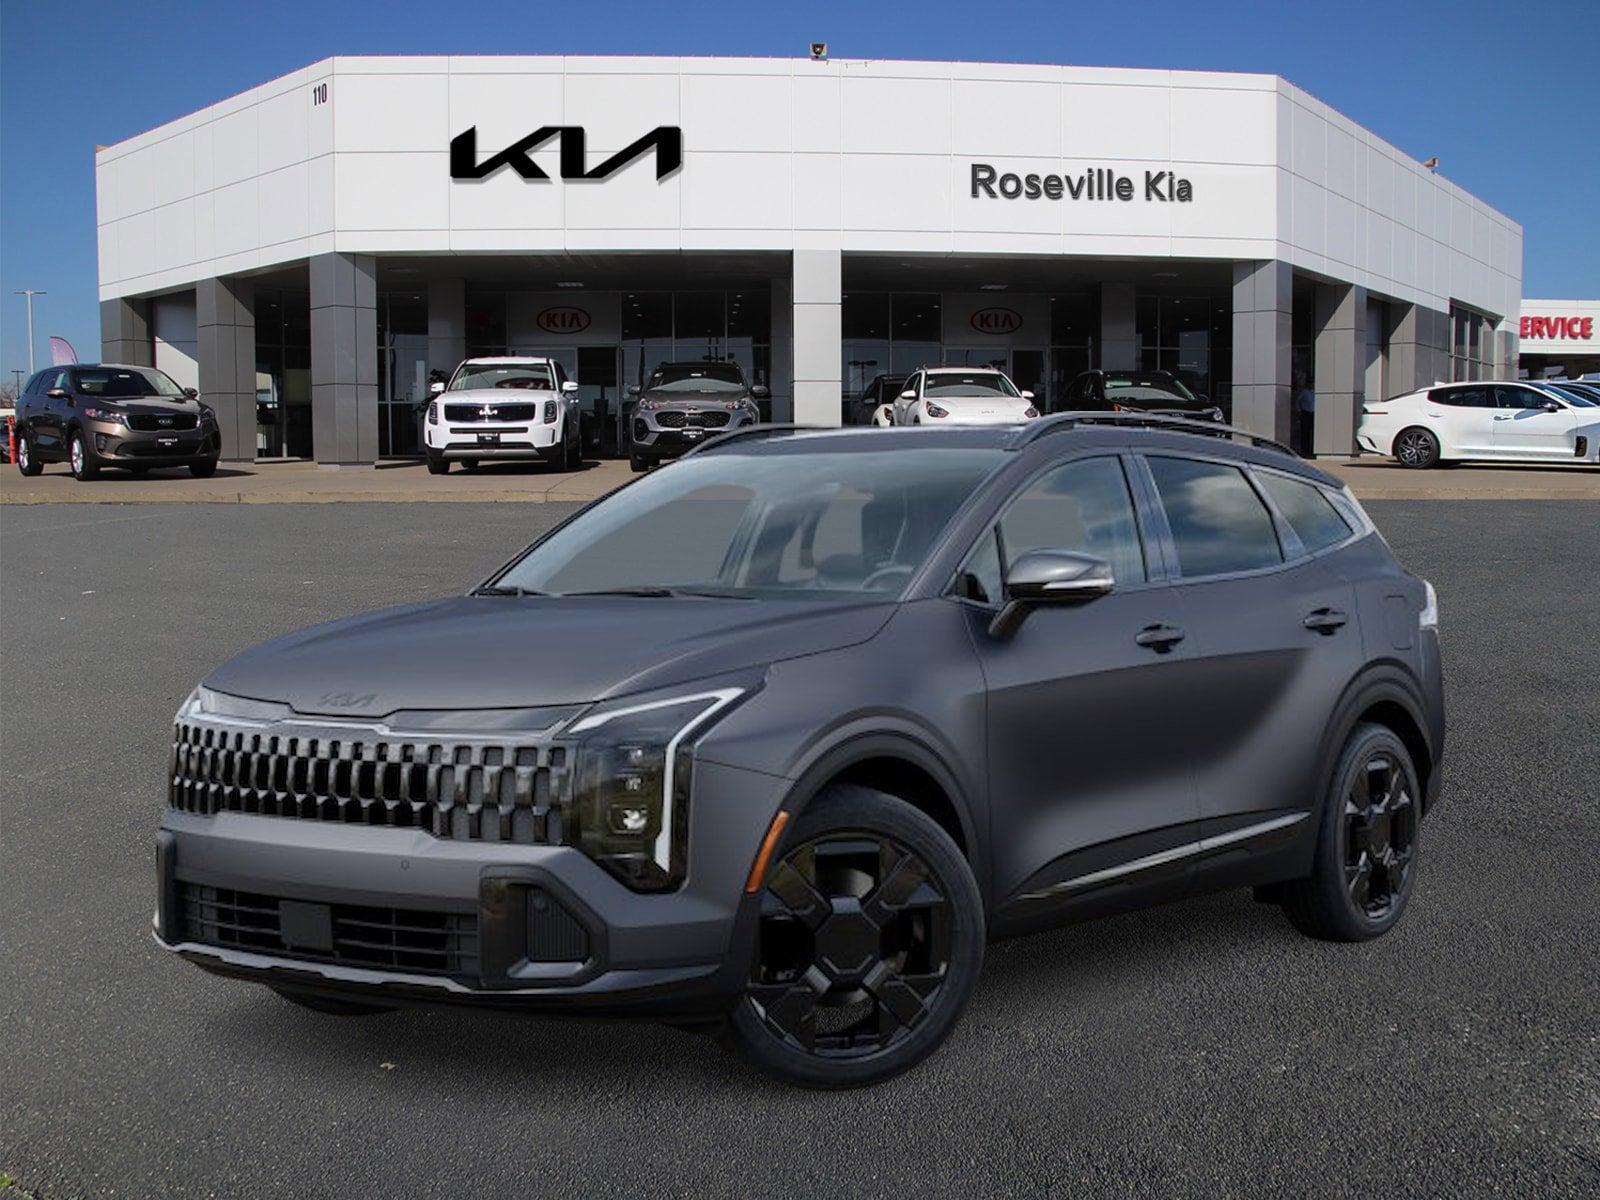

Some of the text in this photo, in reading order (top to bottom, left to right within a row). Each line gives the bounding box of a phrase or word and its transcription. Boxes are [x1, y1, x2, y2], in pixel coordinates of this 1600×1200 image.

[313, 83, 327, 106] 110
[971, 163, 1193, 202] Roseville Kia
[546, 312, 582, 328] KIA
[979, 312, 1015, 329] KIA
[1519, 316, 1594, 339] ERVICE
